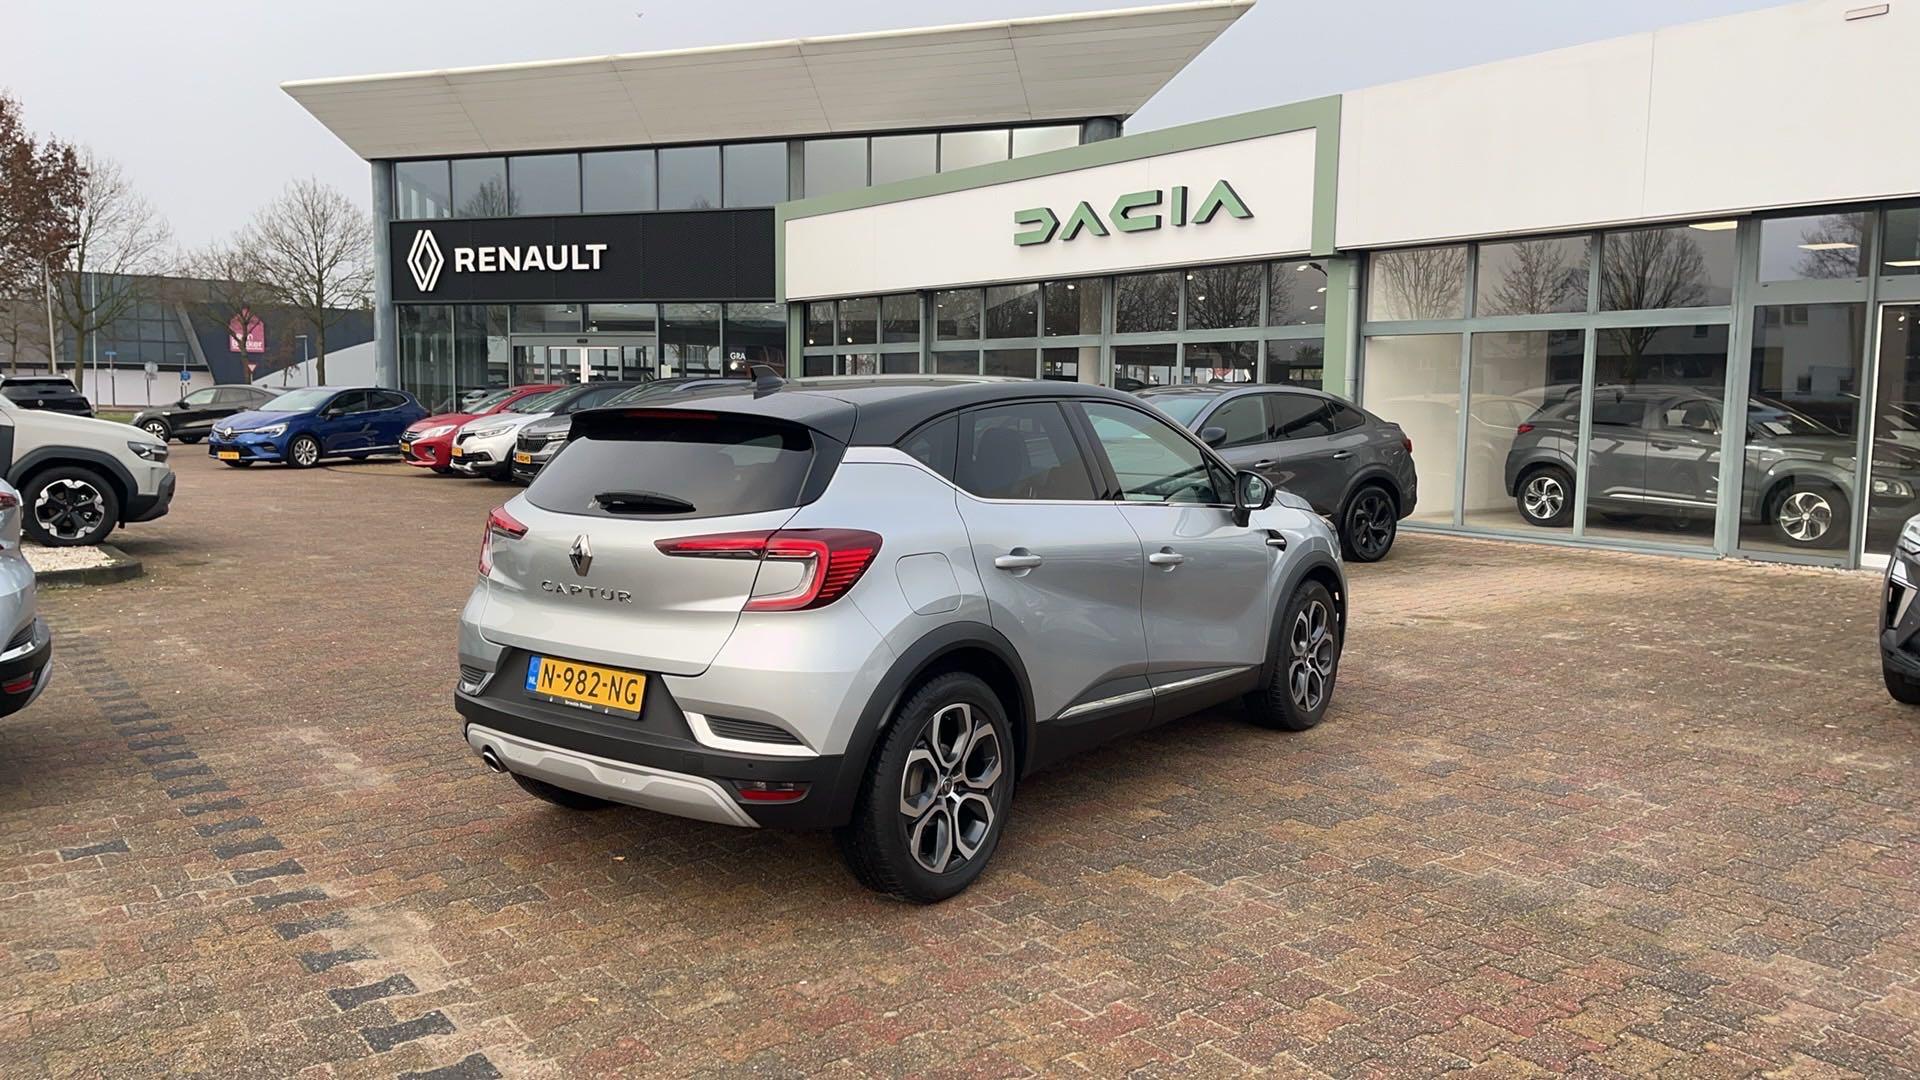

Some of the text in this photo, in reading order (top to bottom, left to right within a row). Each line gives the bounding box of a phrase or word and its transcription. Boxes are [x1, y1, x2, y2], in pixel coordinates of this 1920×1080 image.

[1014, 179, 1254, 246] DACIA
[453, 244, 607, 272] RENAULT
[541, 579, 632, 603] CAPTUR
[528, 675, 537, 685] NL
[541, 663, 639, 705] N-982-NG
